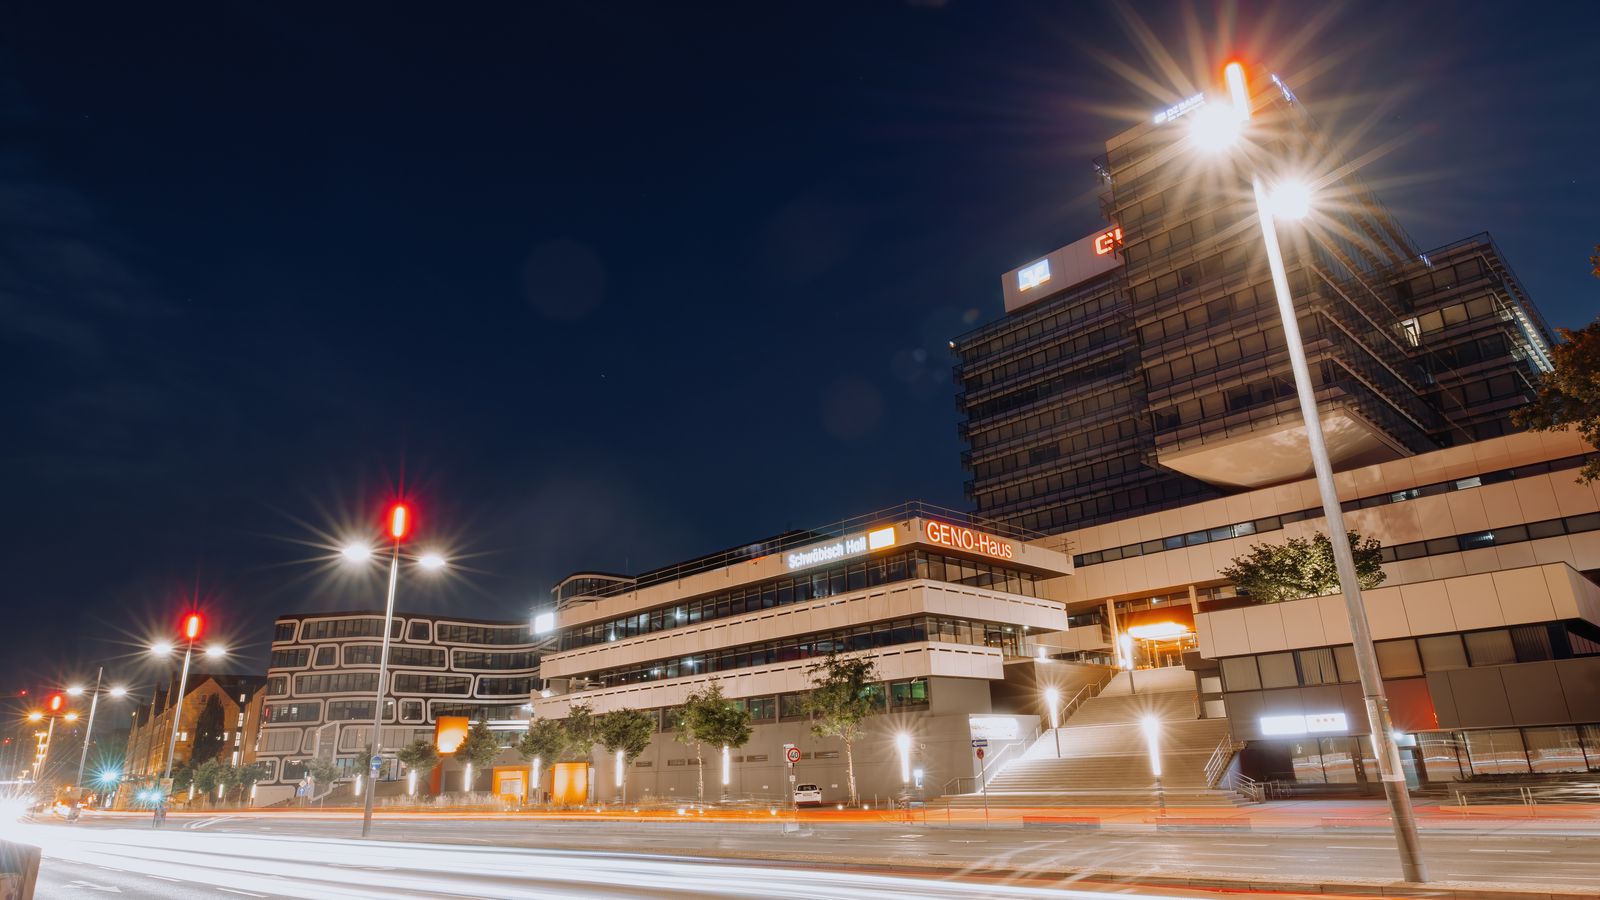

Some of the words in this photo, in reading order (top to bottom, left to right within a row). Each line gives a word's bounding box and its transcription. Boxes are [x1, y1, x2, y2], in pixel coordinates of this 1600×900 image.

[788, 542, 844, 569] Schwäbisch
[846, 537, 867, 555] Hall
[927, 521, 1013, 559] GENO-Haus
[790, 751, 798, 759] 40
